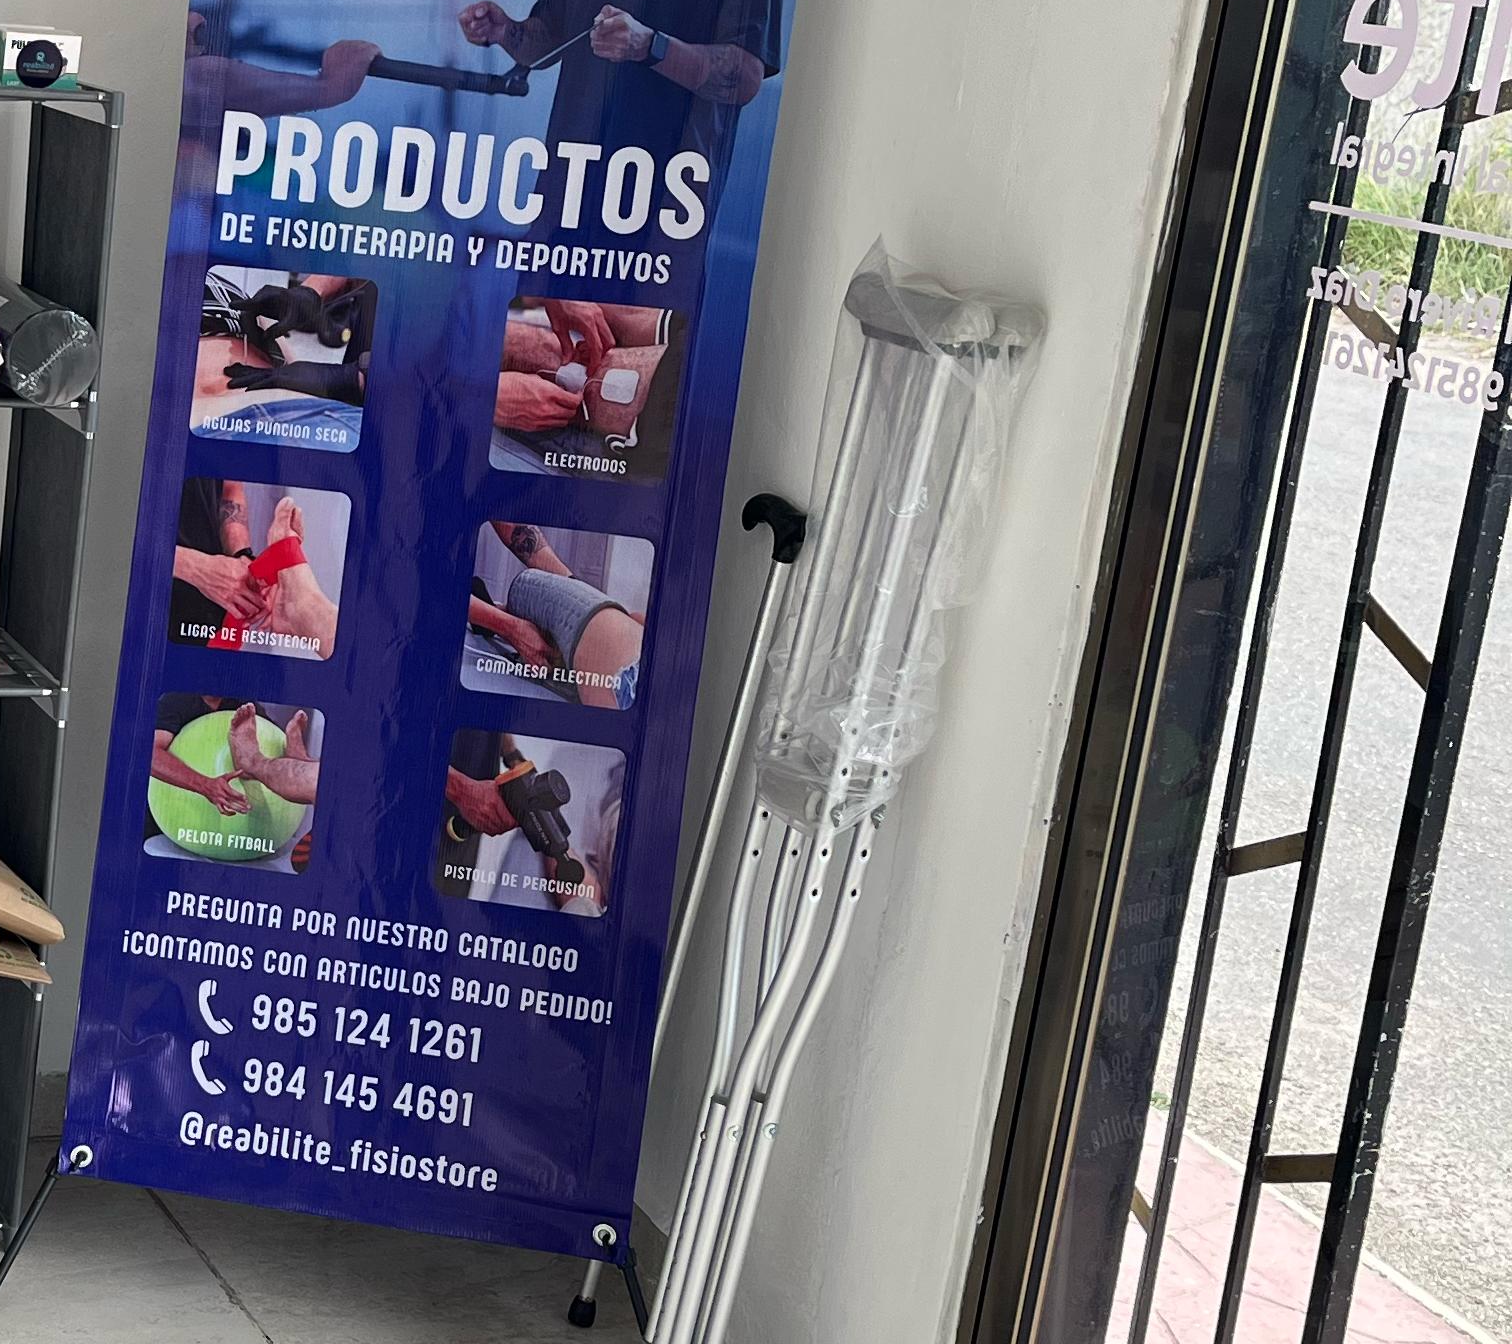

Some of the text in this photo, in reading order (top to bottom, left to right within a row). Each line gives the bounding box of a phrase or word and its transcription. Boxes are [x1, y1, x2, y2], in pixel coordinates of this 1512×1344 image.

[215, 110, 711, 241] PRODUCTOS
[219, 212, 672, 285] DE FISIOTERAPIA Y DEPORTIVOS
[203, 415, 347, 443] AGUJAS PUNCION SECA
[544, 452, 627, 474] ELECTRODOS
[180, 622, 320, 652] LIGAS DE RESISTENCIA
[476, 658, 622, 690] COMPRESA ELECTRICA
[177, 828, 276, 853] PELOTA FITBALL
[444, 864, 595, 899] PISTOLA DE PERCUSION
[166, 890, 578, 973] PREGUNTA POR NUESTRO CATALOGO
[263, 949, 307, 978] CON
[316, 957, 441, 998] ARTICULOS
[451, 977, 510, 1008] BAJO
[519, 987, 613, 1025] PEDIDO!
[251, 994, 482, 1063] 985 124 1261
[243, 1058, 474, 1127] 984 145 4691
[179, 1111, 499, 1192] @reabilite_fisiostore
